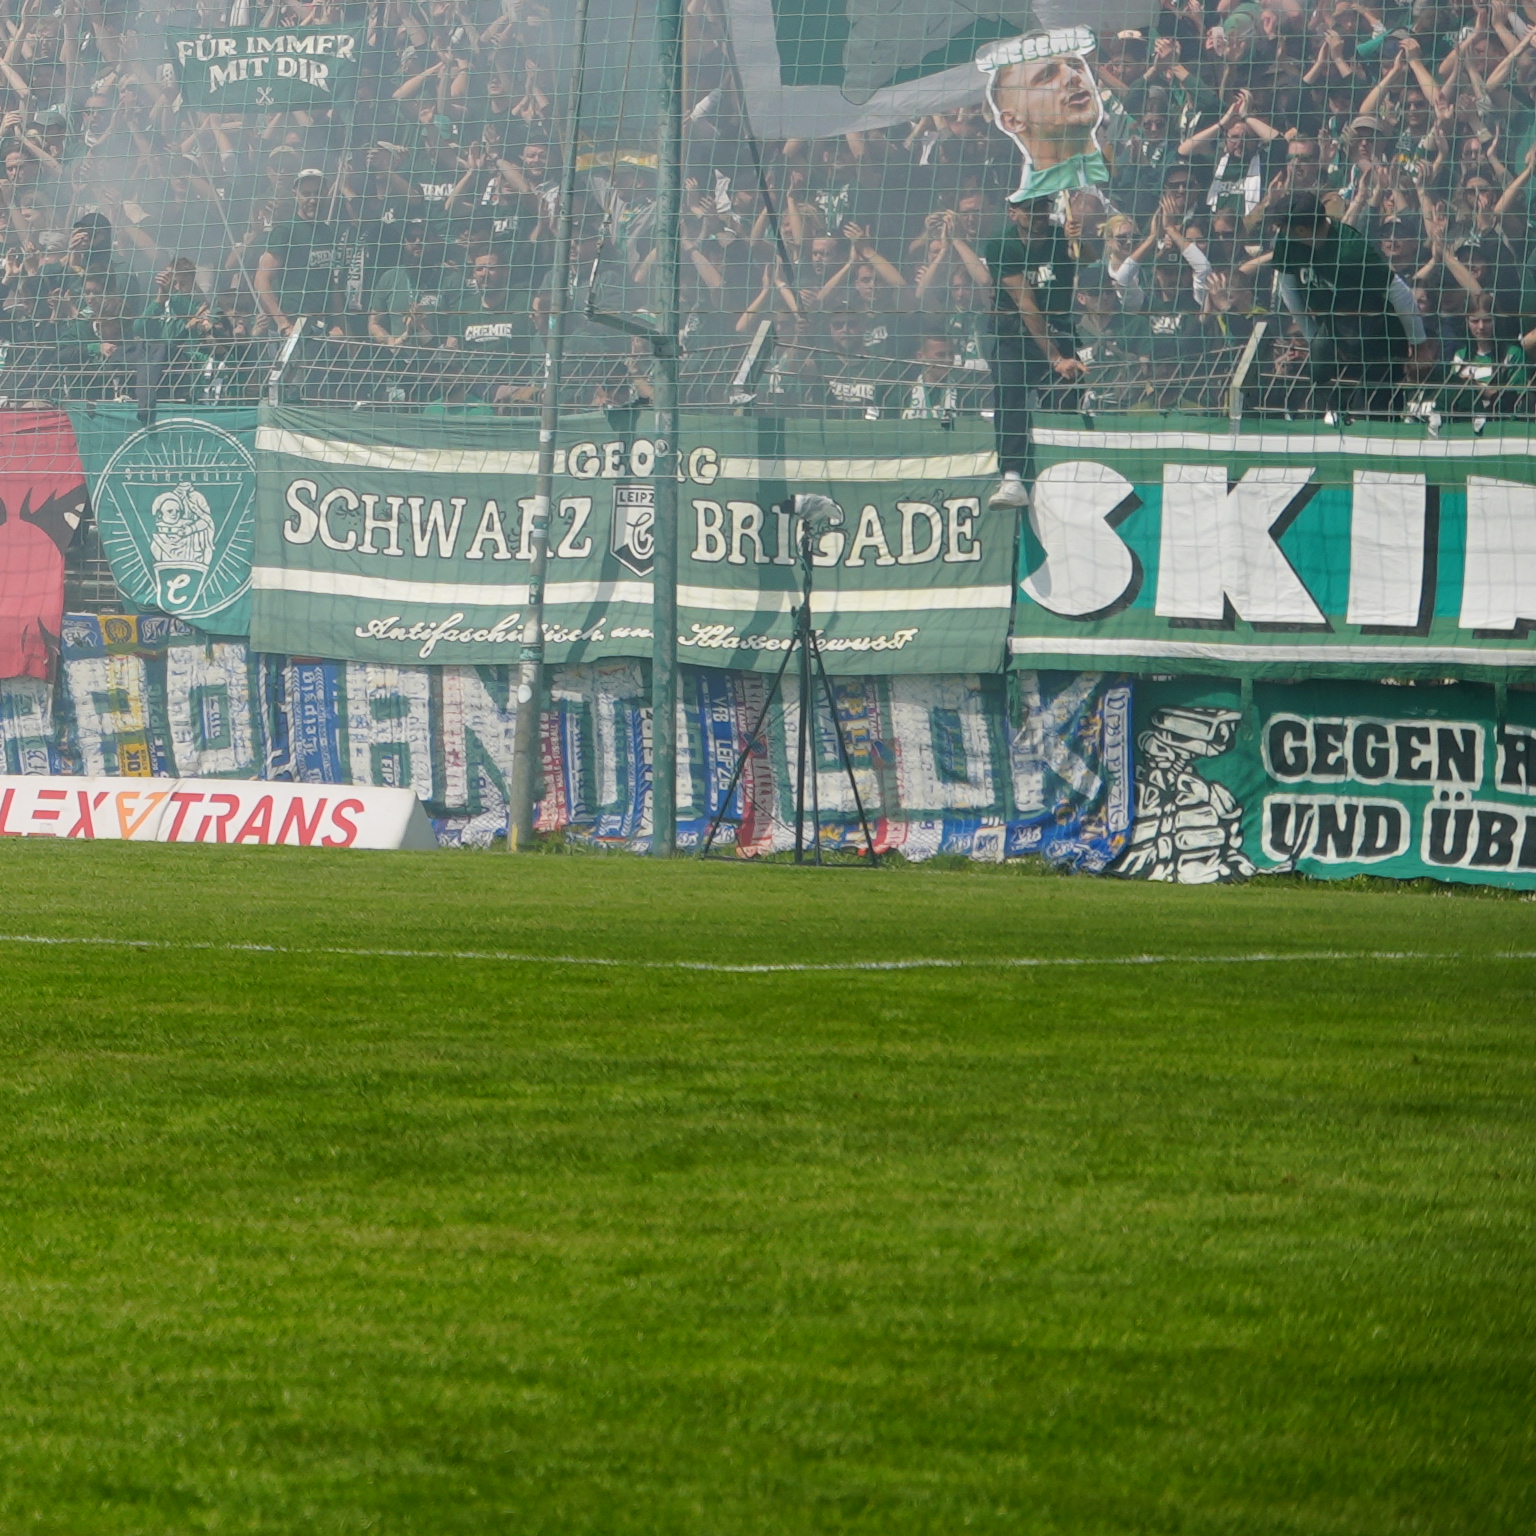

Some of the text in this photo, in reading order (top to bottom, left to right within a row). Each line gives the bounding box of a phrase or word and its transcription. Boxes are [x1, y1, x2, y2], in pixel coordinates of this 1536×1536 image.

[176, 33, 357, 67] FÜR IMMER
[208, 57, 331, 93] MIT DIR
[464, 322, 513, 341] CHEMIE
[1262, 713, 1485, 786] GEGEN
[156, 792, 367, 849] TRANS
[1261, 795, 1410, 862] UND
